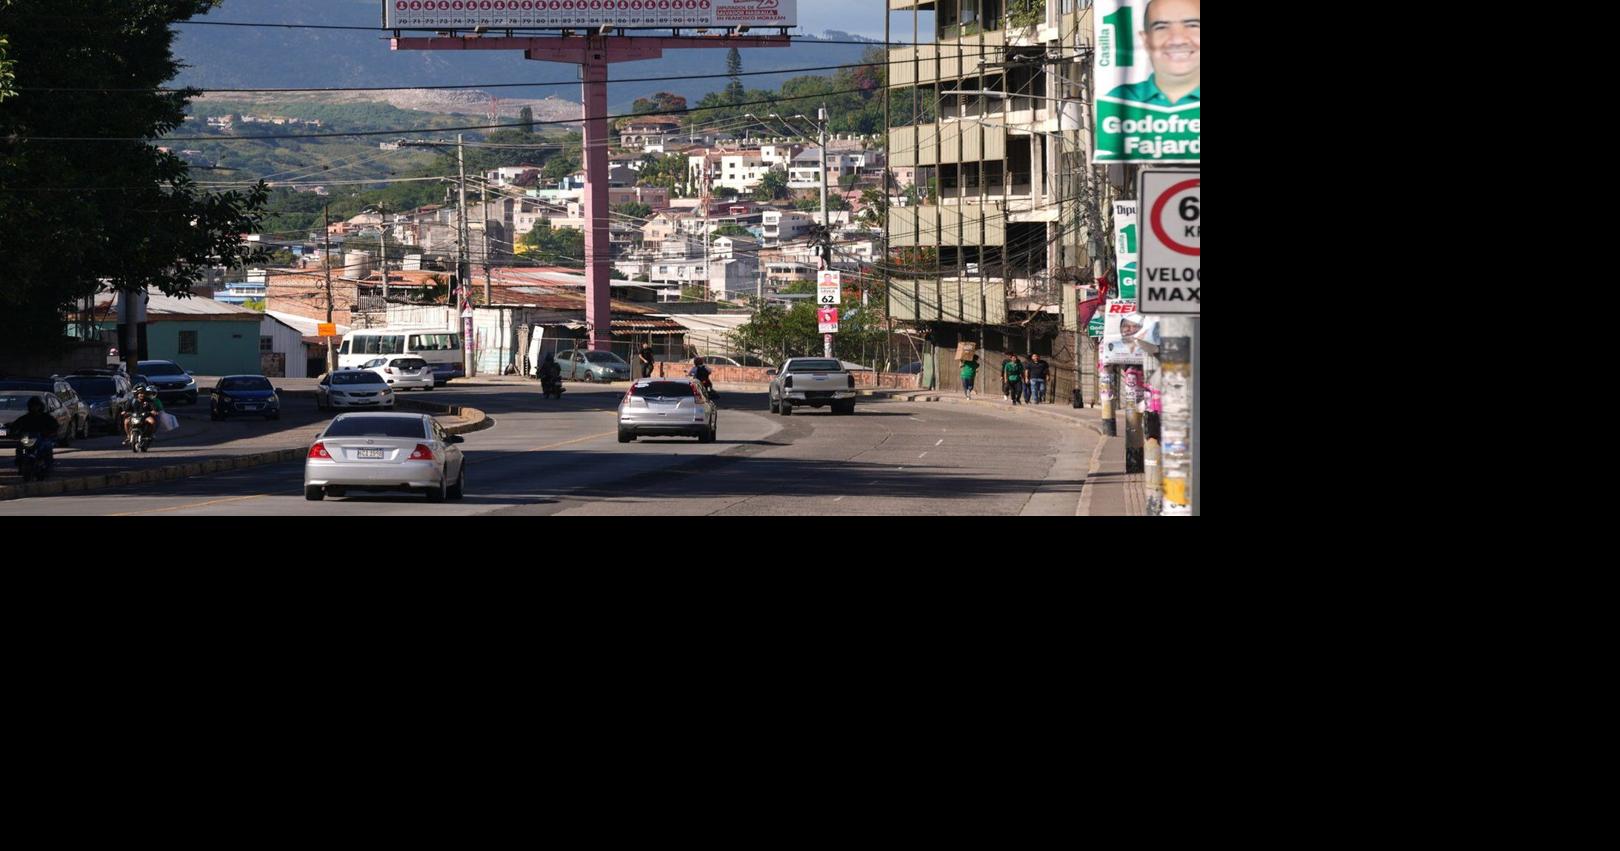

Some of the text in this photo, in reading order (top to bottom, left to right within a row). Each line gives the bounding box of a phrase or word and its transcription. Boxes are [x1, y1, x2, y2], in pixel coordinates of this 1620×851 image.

[1098, 28, 1110, 67] Casilla
[1103, 6, 1134, 67] 1
[1102, 114, 1200, 134] Godofre
[1120, 224, 1136, 254] 1
